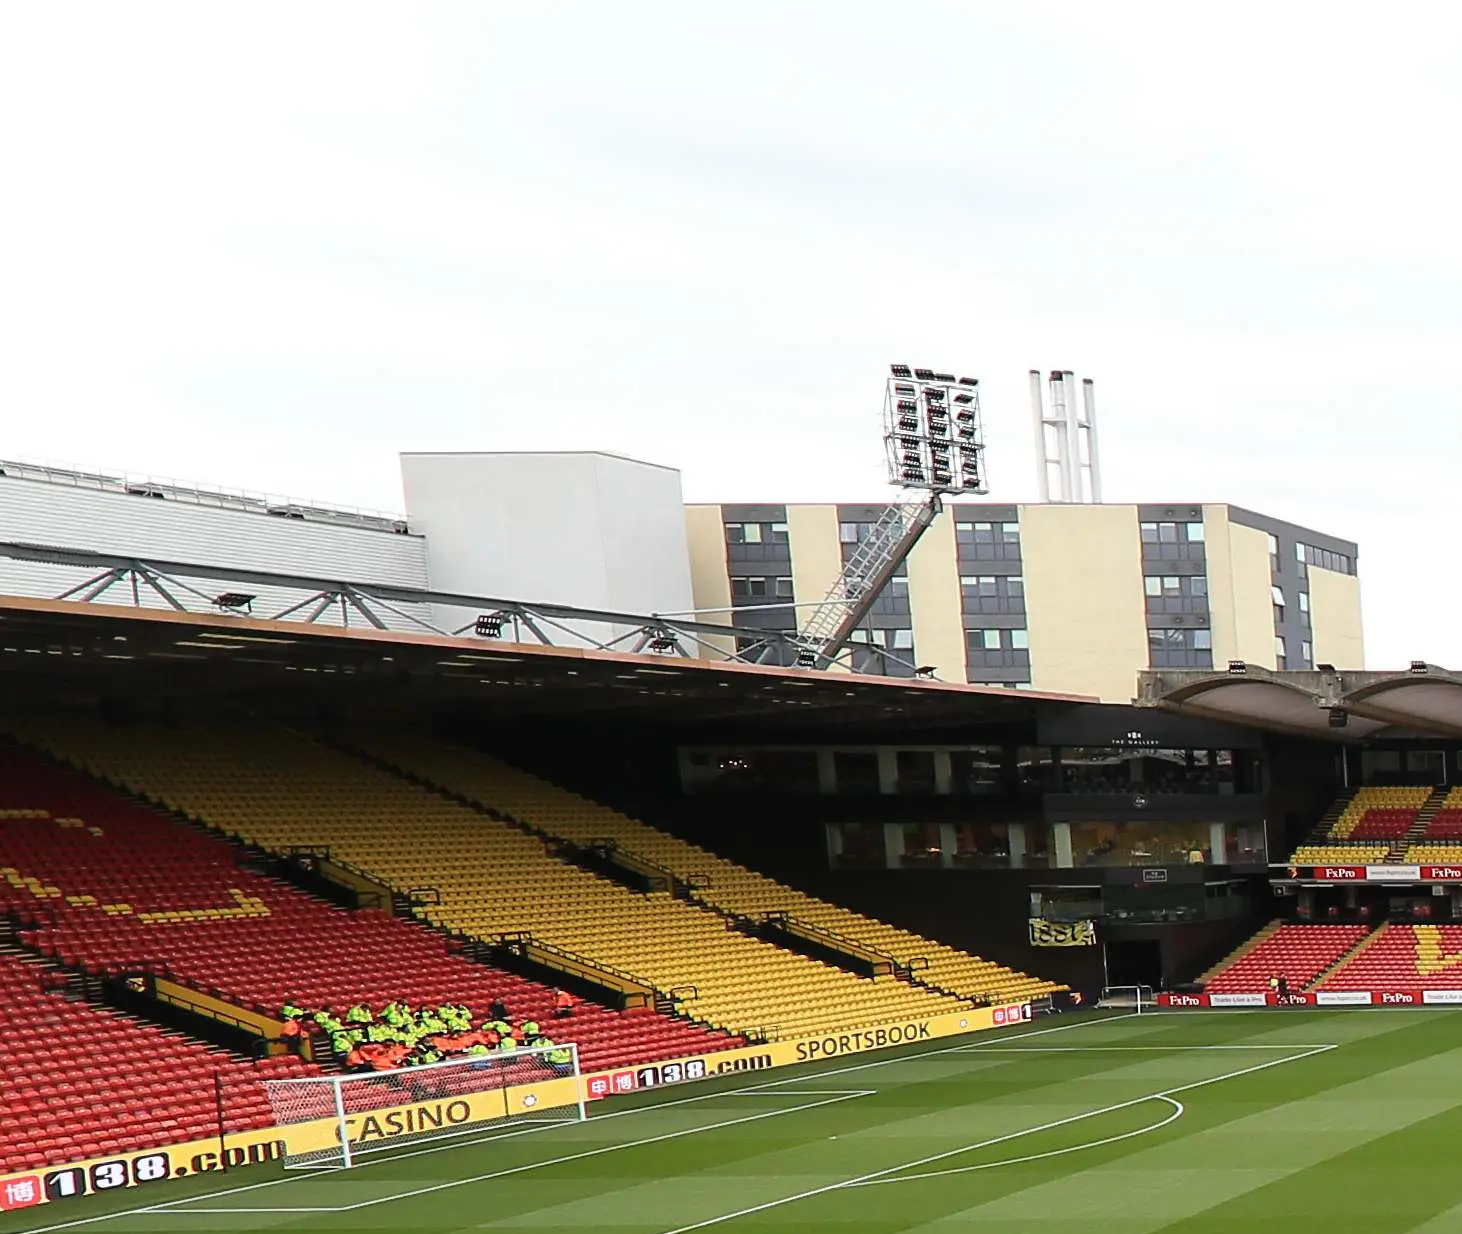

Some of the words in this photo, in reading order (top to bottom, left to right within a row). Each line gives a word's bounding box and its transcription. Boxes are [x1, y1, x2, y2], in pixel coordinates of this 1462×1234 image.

[1326, 868, 1355, 878] FxPro
[1432, 868, 1461, 878] FxPro
[1169, 994, 1200, 1006] FxPro
[1383, 992, 1412, 1003] FxPro
[796, 1022, 931, 1061] SPORTSBOOK
[637, 1054, 772, 1089] 138.com
[335, 1100, 471, 1143] CASINO
[47, 1140, 285, 1199] 138.com
[4, 1179, 36, 1205] 博
